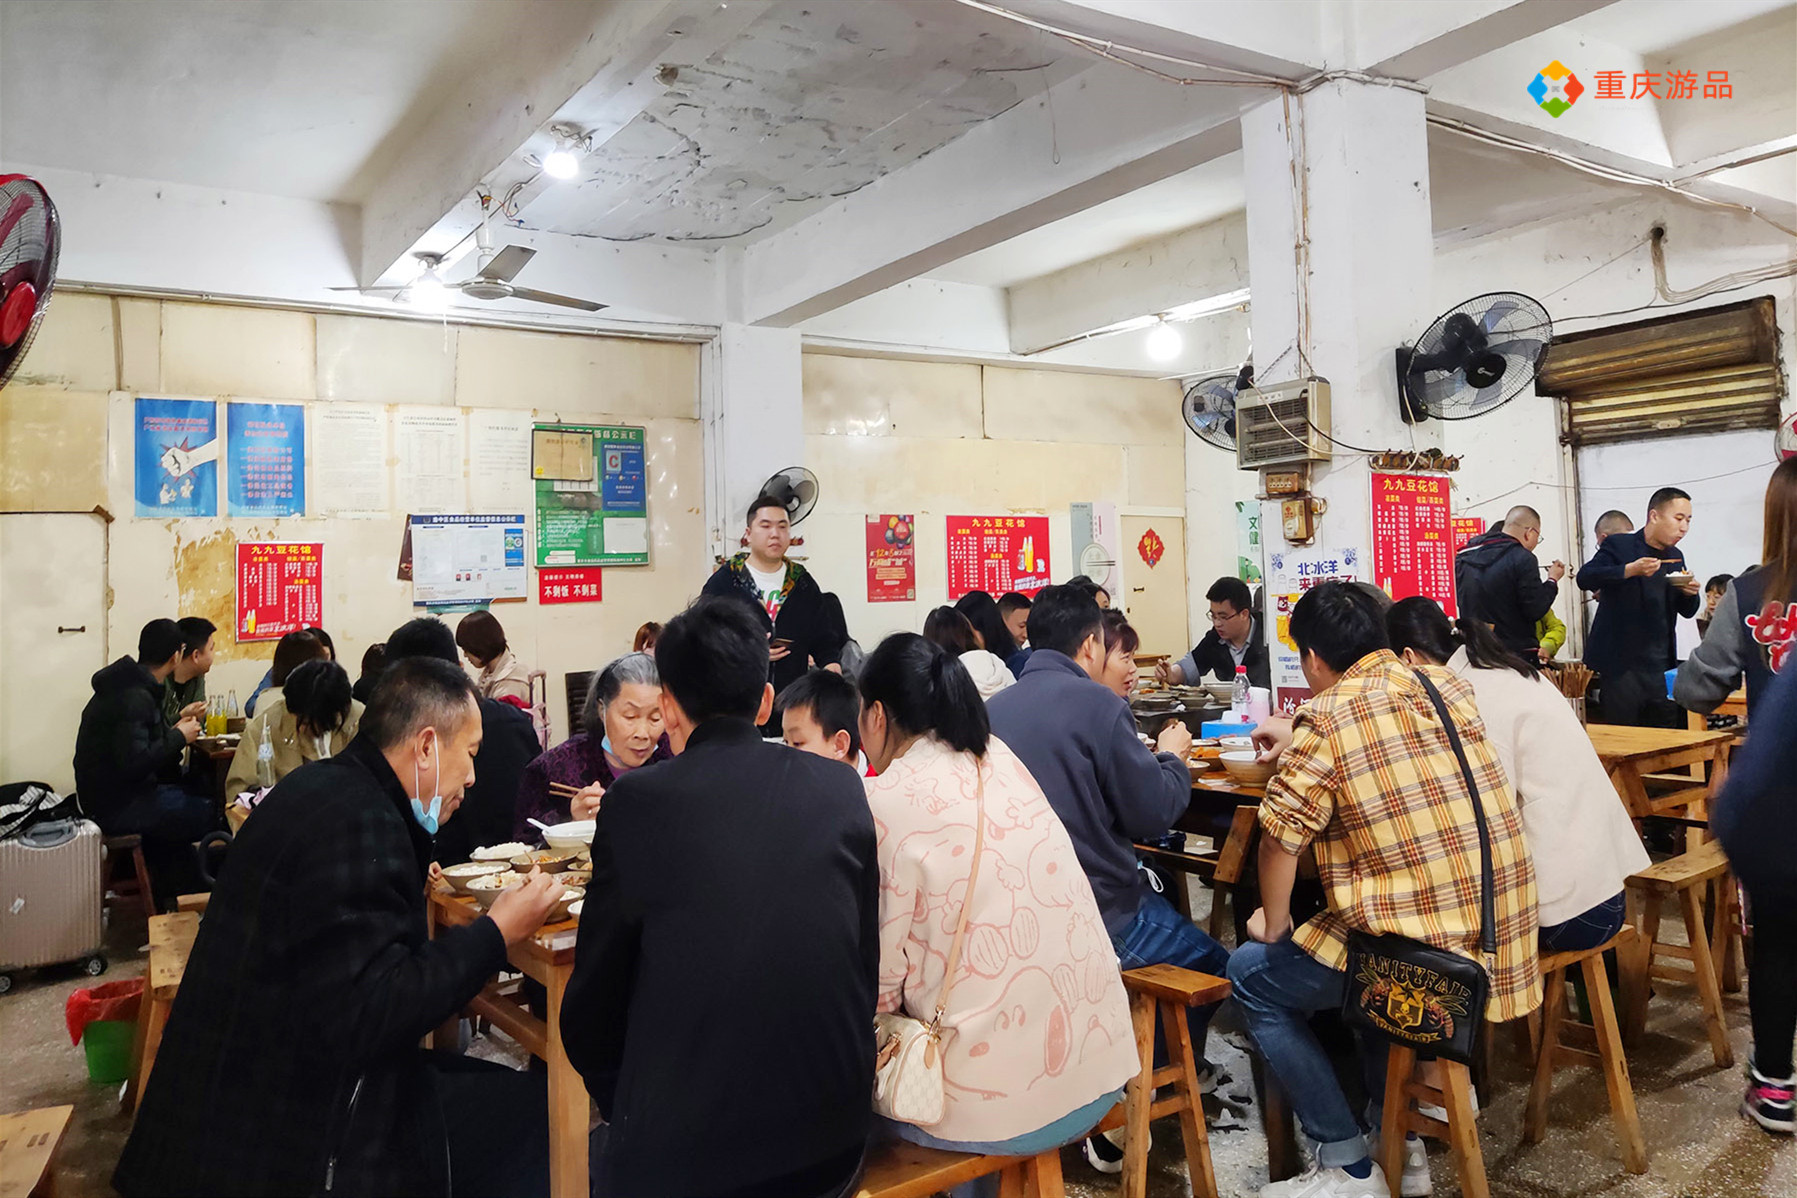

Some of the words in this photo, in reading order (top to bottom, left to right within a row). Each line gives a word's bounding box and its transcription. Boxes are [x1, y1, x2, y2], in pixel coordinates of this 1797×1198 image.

[608, 455, 619, 469] C
[1383, 478, 1440, 493] 九九豆花馆
[972, 518, 1026, 528] 九九豆花馆
[1248, 516, 1258, 530] 文
[251, 545, 312, 555] 九九豆花馆
[1297, 560, 1339, 576] 北冰洋
[544, 585, 570, 598] 不剩饭
[573, 583, 598, 597] 不剩菜
